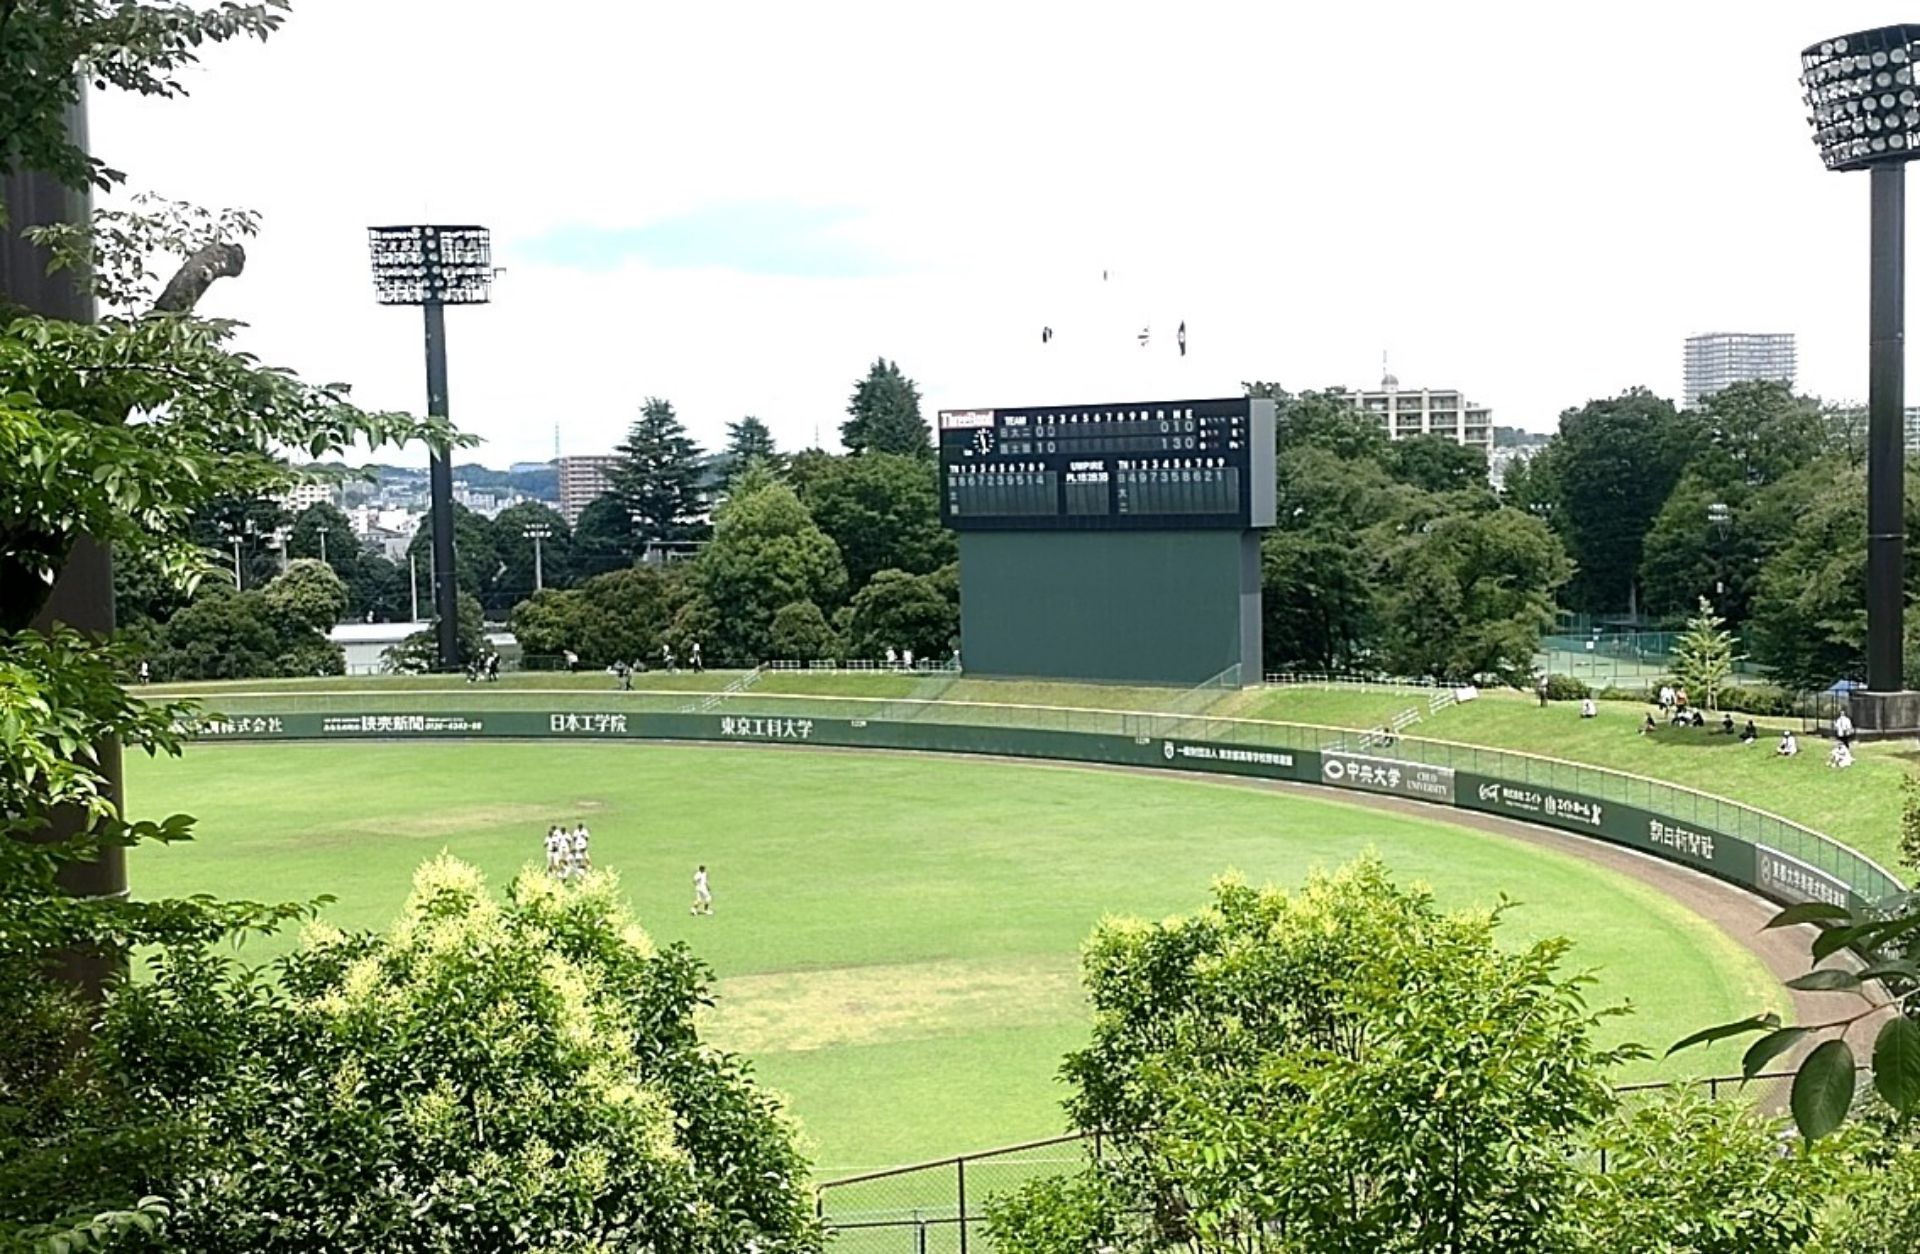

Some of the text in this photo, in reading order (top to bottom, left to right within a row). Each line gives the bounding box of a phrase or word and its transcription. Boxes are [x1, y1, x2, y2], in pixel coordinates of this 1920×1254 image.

[1004, 416, 1026, 425] TEAM
[1070, 461, 1104, 470] UMPIRE
[168, 716, 283, 734] 株式会社
[362, 716, 424, 731] 読売新聞
[550, 713, 627, 732] 日本工学院
[721, 716, 813, 738] 東京工科大学
[1347, 760, 1401, 788] 中央大学
[1406, 780, 1448, 796] UNIVERSITY
[1650, 818, 1714, 860] 朝日新聞社
